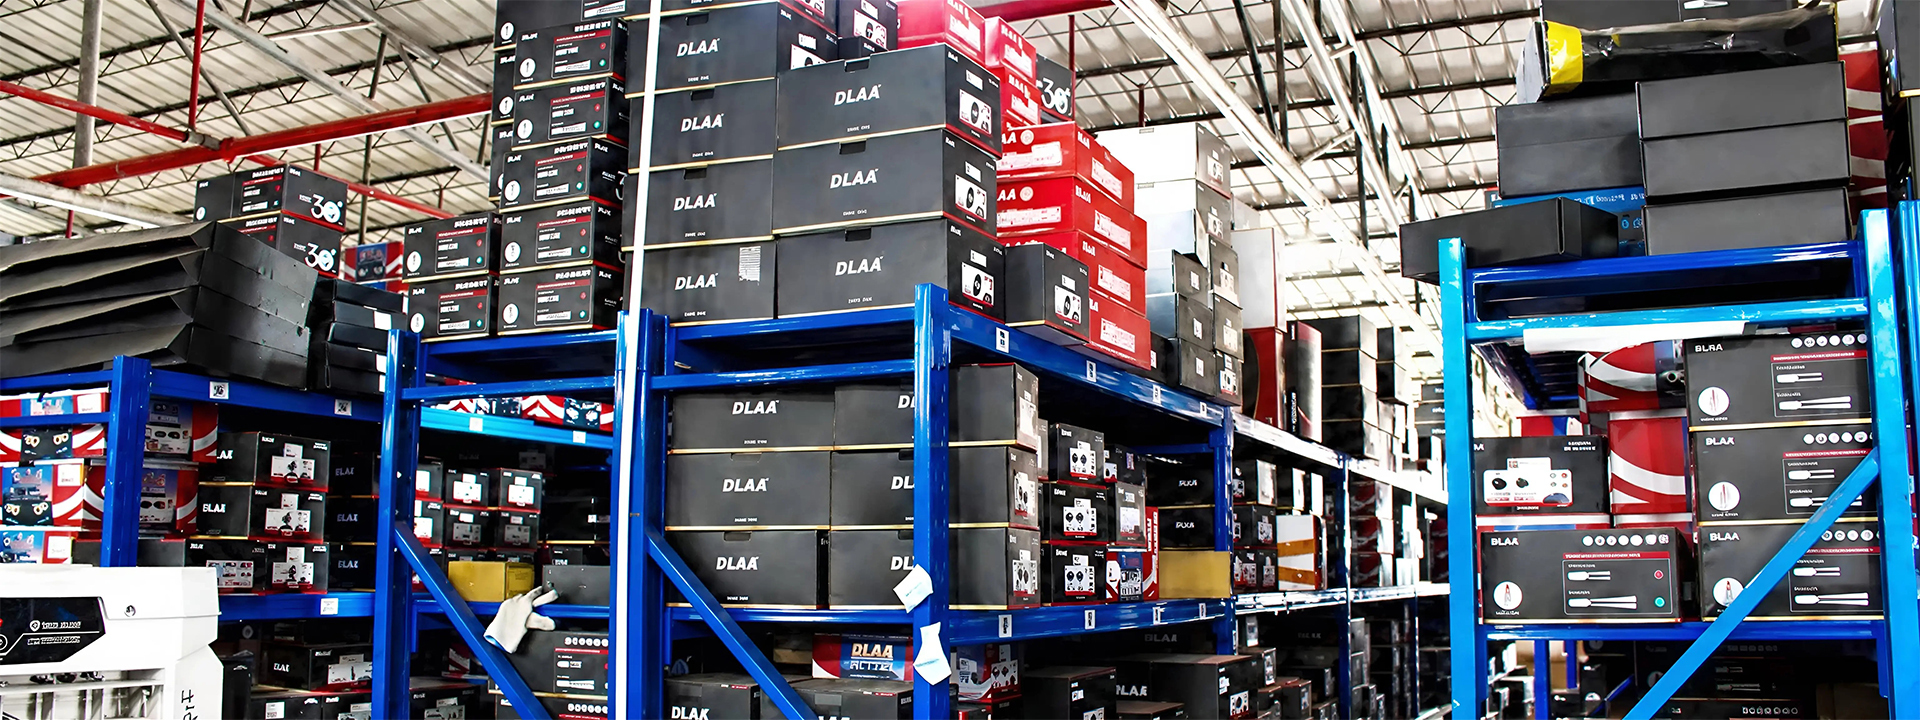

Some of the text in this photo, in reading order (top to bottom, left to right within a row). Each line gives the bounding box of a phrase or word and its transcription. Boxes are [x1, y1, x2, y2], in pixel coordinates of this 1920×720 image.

[676, 38, 720, 57] DLAA
[833, 84, 881, 105] DLAA
[680, 113, 724, 132] DLAA
[830, 168, 879, 189] DLAA
[673, 193, 717, 211] DLAA
[997, 188, 1016, 201] AA
[835, 256, 884, 276] DLAA
[674, 273, 718, 290] DLAA
[732, 400, 779, 415] DLAA
[722, 478, 769, 492] DLAA
[890, 475, 914, 489] DL
[716, 557, 759, 570] DLAA
[890, 556, 913, 570] DL
